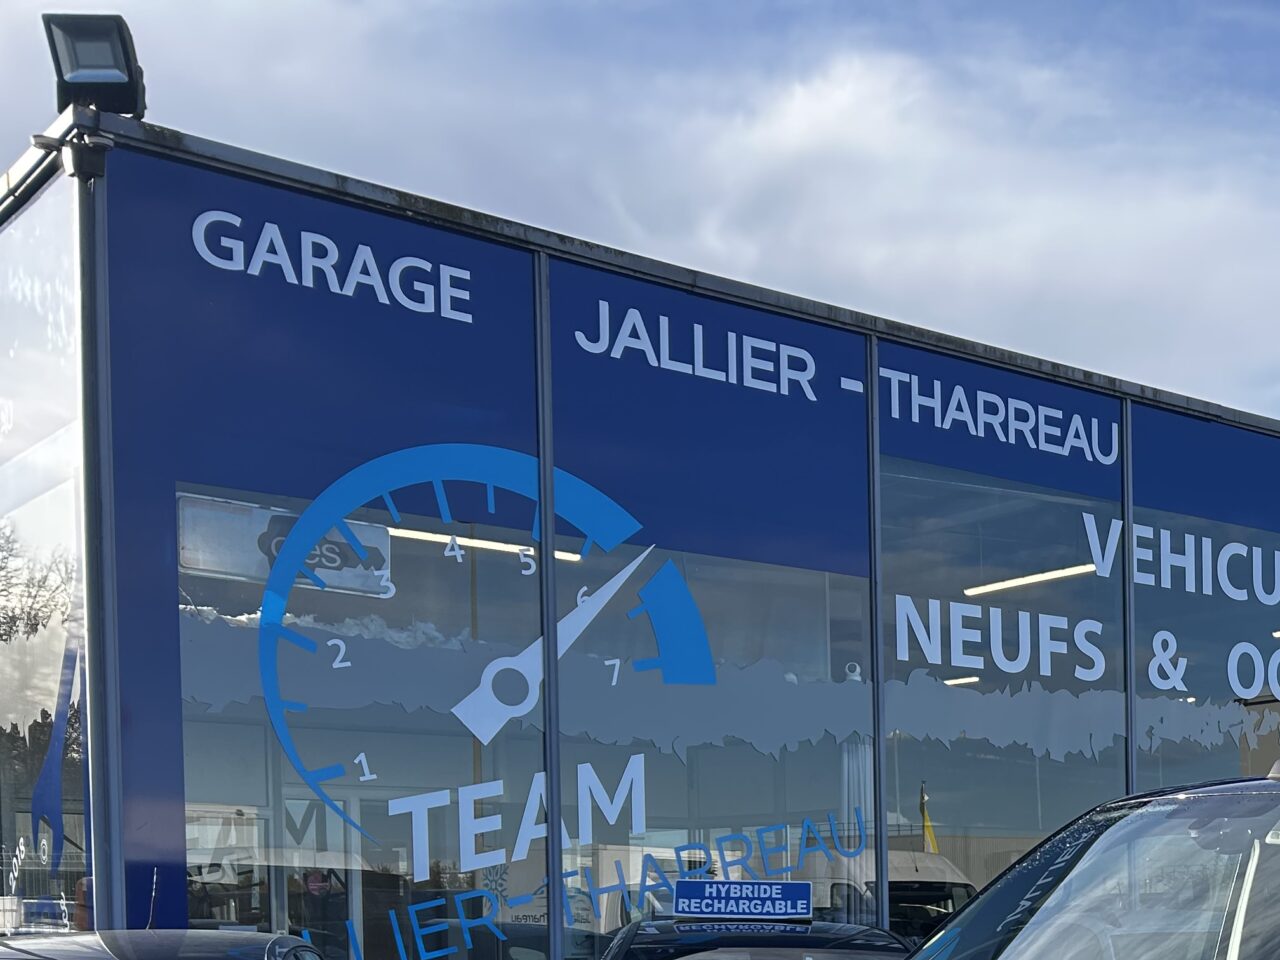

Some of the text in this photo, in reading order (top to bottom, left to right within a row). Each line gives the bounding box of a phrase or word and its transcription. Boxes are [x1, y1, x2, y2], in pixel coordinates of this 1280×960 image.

[191, 210, 472, 323] GARAGE
[574, 300, 817, 401] JALLIER
[879, 367, 1119, 465] THARREAU
[444, 535, 465, 563] 4
[519, 547, 536, 576] 5
[374, 569, 396, 599] 3
[326, 638, 351, 669] 2
[896, 594, 1106, 682] NEUFS
[1148, 630, 1188, 691] &
[604, 658, 620, 686] 7
[353, 752, 377, 782] 1
[389, 753, 647, 883] TEAM
[677, 898, 808, 913] RECHARGABLE
[705, 883, 783, 898] HYBRIDE
